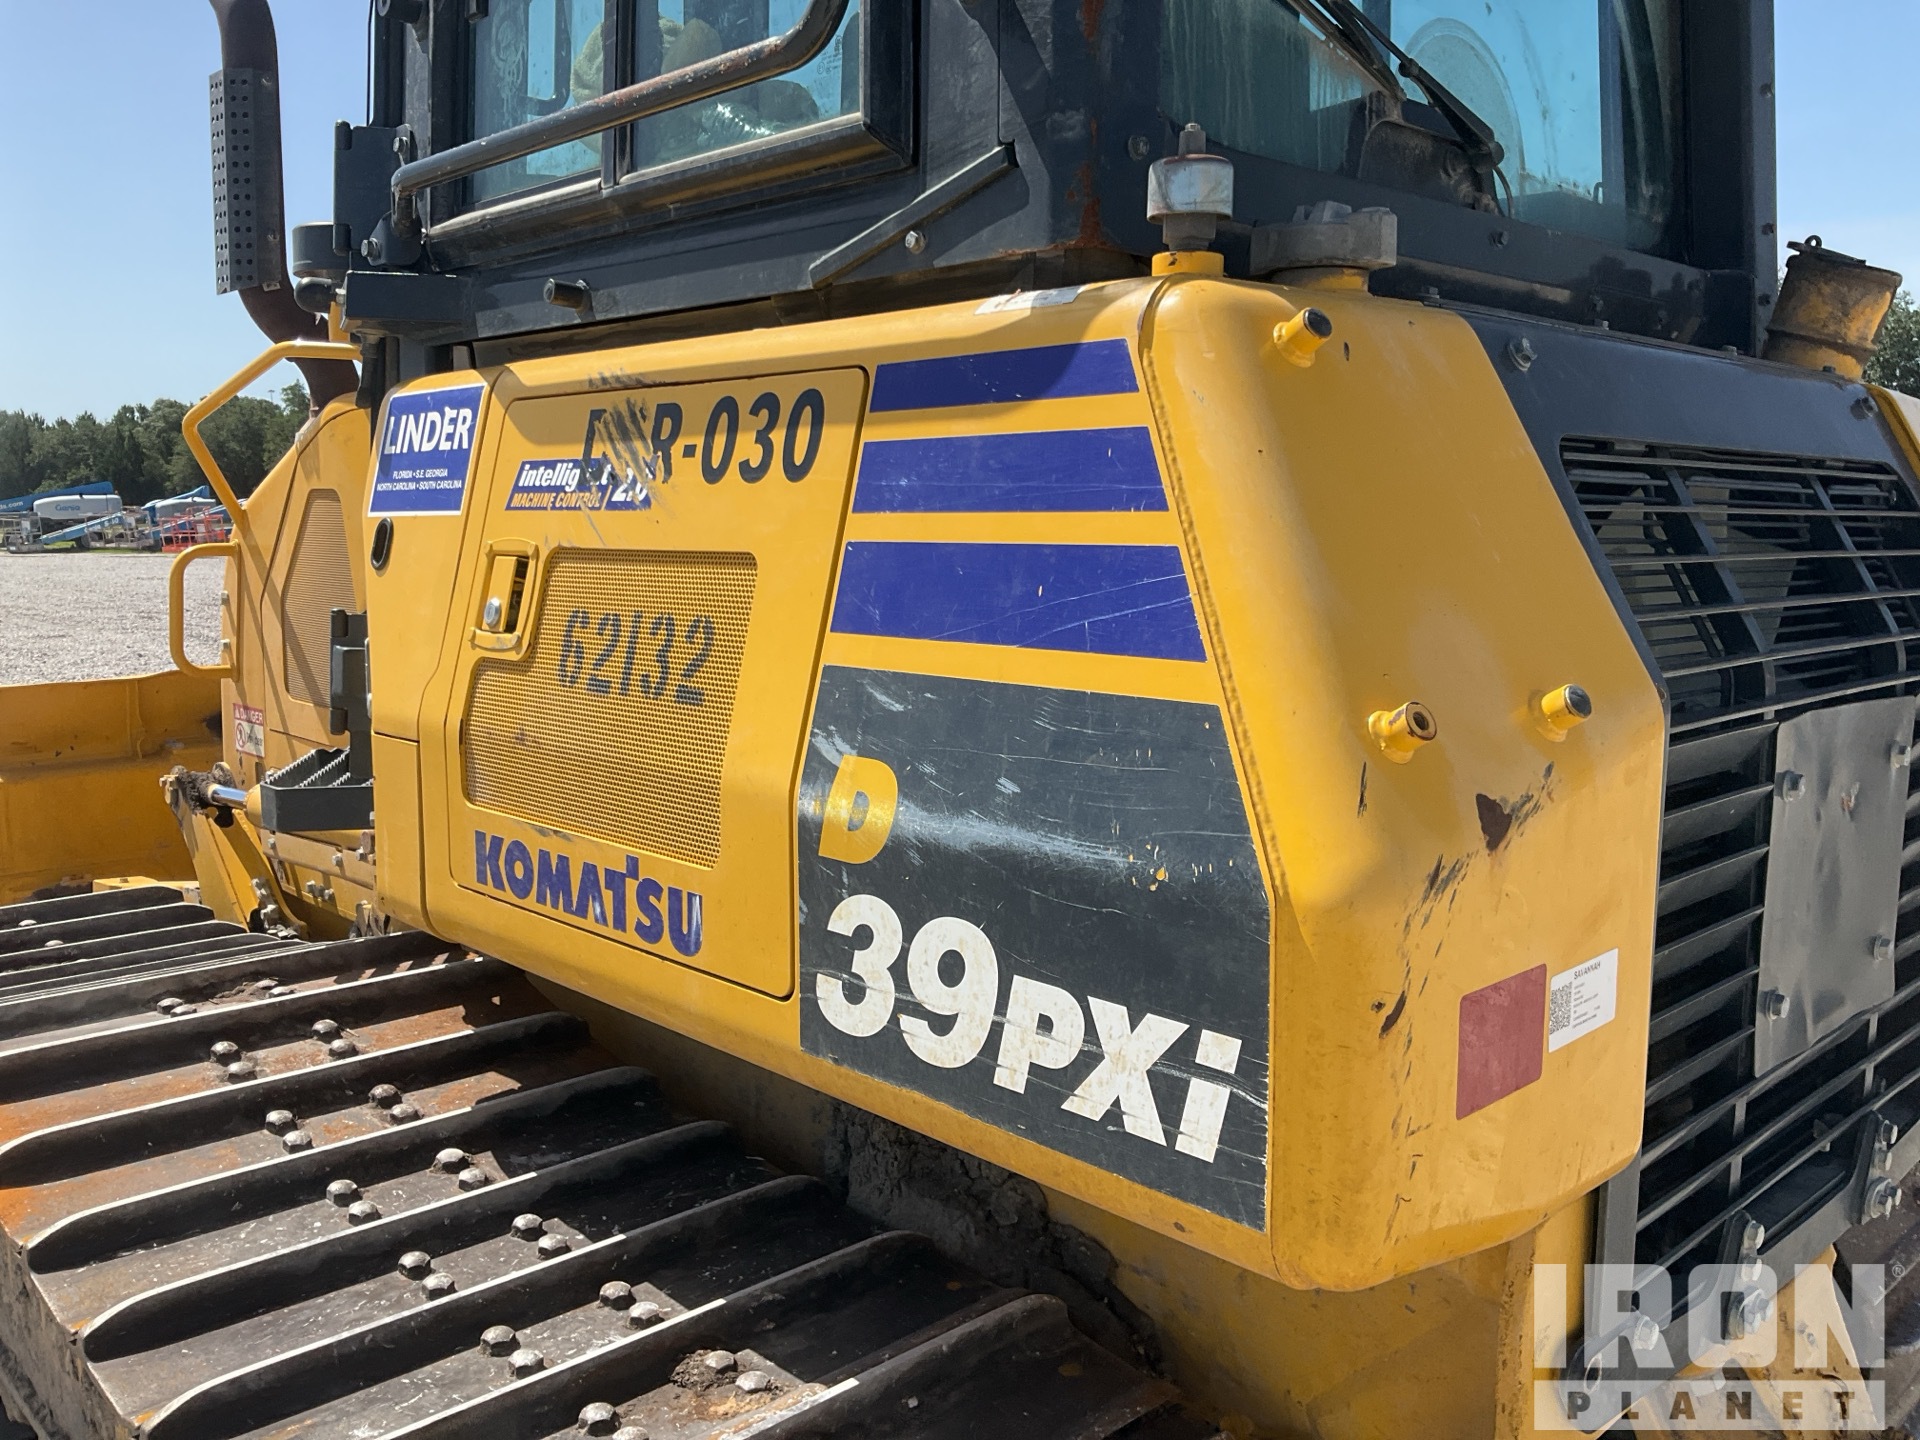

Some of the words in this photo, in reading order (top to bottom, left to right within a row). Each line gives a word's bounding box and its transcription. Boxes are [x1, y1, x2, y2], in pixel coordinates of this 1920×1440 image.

[384, 407, 472, 454] LINDER
[376, 483, 392, 491] NORTH
[392, 482, 416, 491] CAROLINA
[419, 481, 436, 490] SOUTH
[436, 480, 462, 489] CAROLINA
[392, 470, 413, 480] FLORIDA
[425, 468, 448, 478] GEORGIA
[55, 504, 80, 512] Genie
[511, 492, 557, 507] MACHINE
[557, 492, 602, 508] CONTROL
[558, 609, 714, 706] 62132
[818, 754, 899, 865] D
[474, 830, 704, 957] KOMATSU
